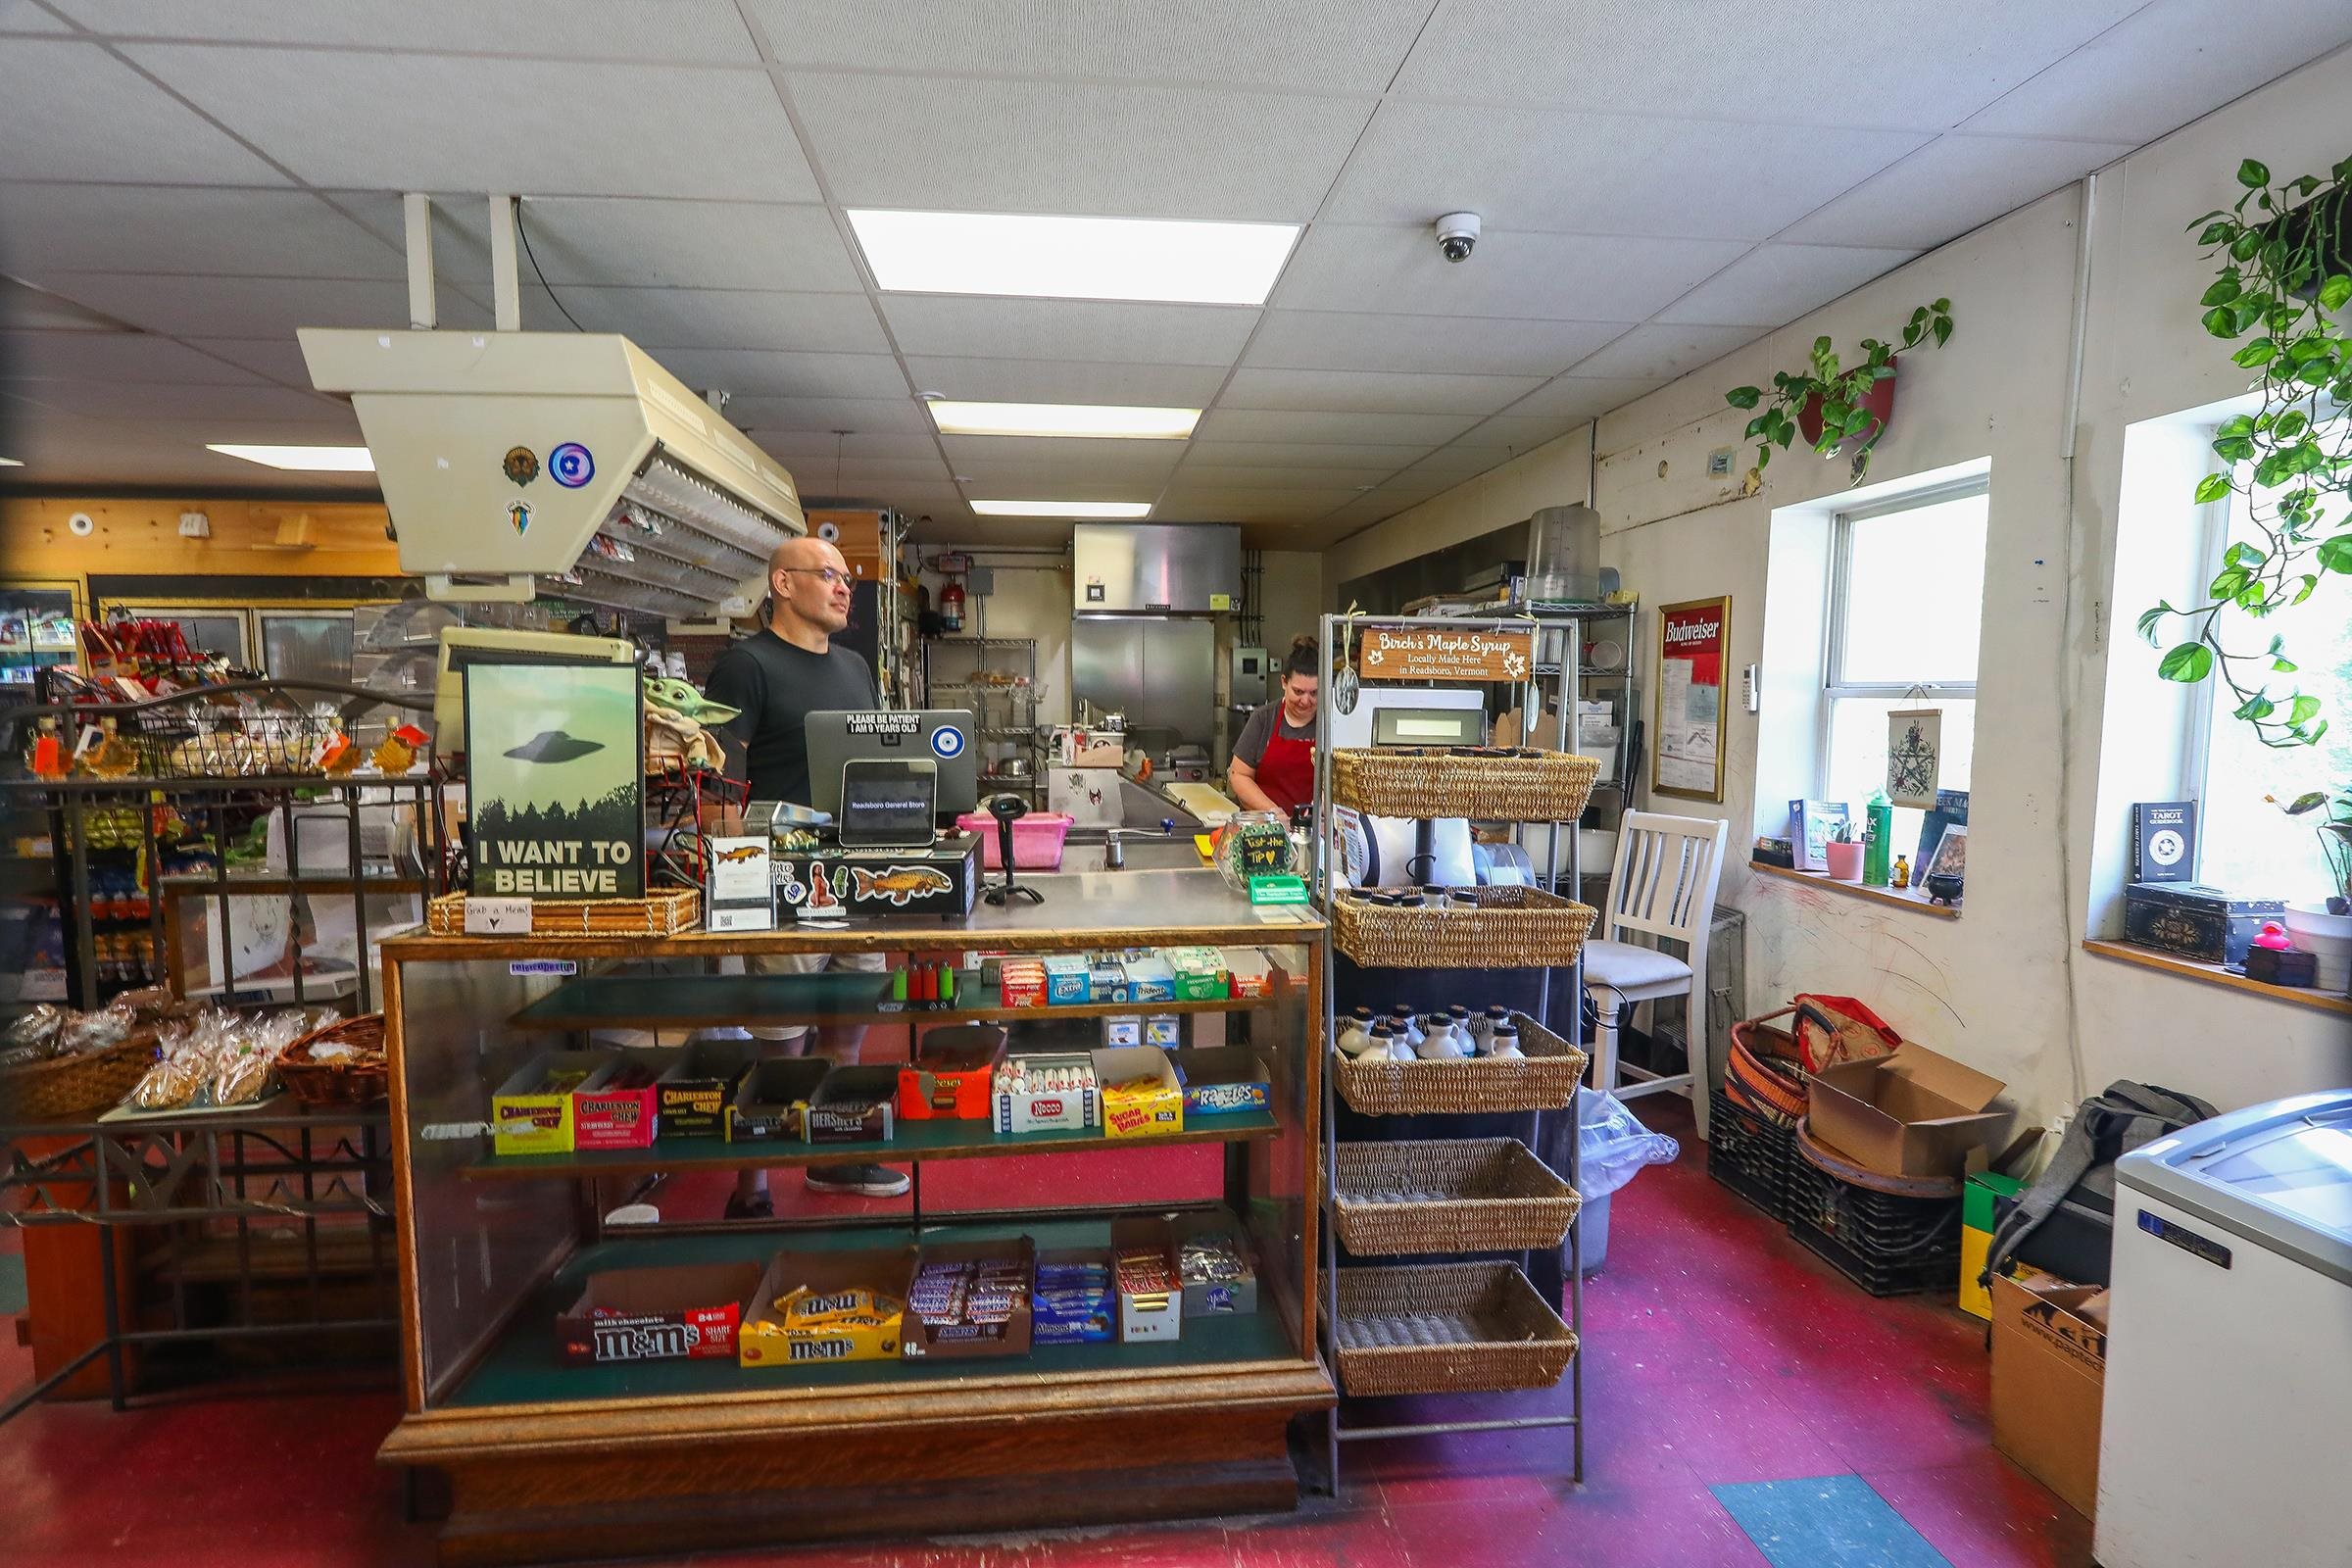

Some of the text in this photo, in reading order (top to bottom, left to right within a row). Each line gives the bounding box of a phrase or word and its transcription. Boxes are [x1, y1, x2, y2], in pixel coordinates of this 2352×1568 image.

[1665, 617, 1719, 643] Budweiser
[1379, 633, 1511, 657] Birch's Maple Syrup
[1407, 654, 1482, 665] Locally Made Here
[1399, 665, 1489, 677] in Readsboro, Vermont
[847, 713, 920, 724] PLEASE BE PATIENT
[851, 723, 855, 733] I
[855, 723, 867, 733] AM
[875, 723, 901, 733] YEARS
[902, 723, 917, 733] OLD
[2151, 811, 2182, 820] TAROT
[1267, 837, 1284, 847] the
[479, 840, 631, 864] I WANT TO
[495, 869, 617, 893] BELIEVE
[467, 904, 487, 916] Grab
[1137, 986, 1166, 995] Trident
[663, 1090, 721, 1105] CHARLESTON
[580, 1100, 640, 1114] CHARLESTON
[693, 1102, 721, 1114] CHEW
[611, 1110, 640, 1125] CHEW
[1109, 1108, 1142, 1125] SUGAR
[1117, 1113, 1151, 1133] BABIES
[706, 1325, 732, 1335] SHARE
